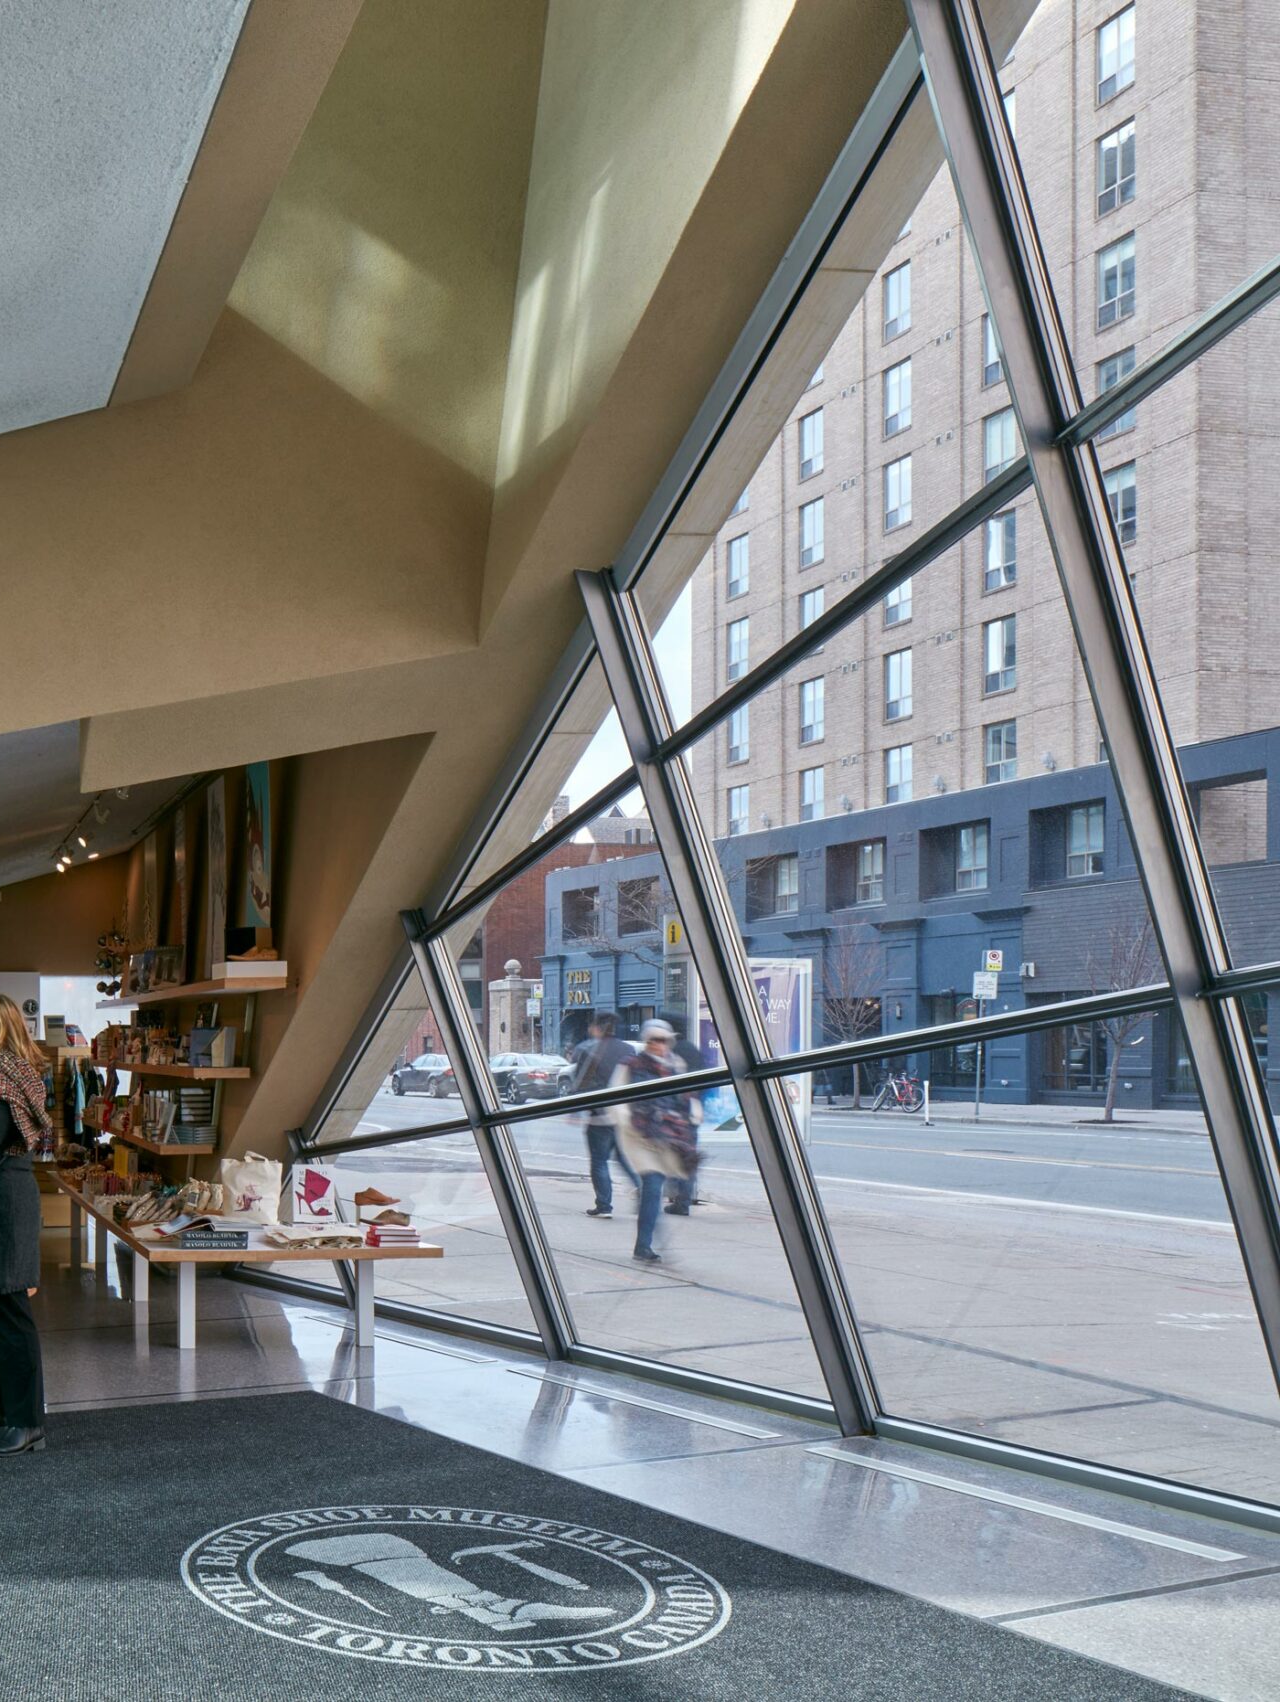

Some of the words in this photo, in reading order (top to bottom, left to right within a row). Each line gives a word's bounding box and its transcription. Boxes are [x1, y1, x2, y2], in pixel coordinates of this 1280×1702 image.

[567, 970, 590, 985] THE
[567, 990, 590, 1005] FOX
[261, 1507, 393, 1532] SHOE
[409, 1507, 653, 1557] MUSEUM
[196, 1529, 271, 1568] BATA
[198, 1573, 271, 1613] THE
[299, 1623, 621, 1665] TORONTO
[621, 1573, 715, 1650] CANADA
